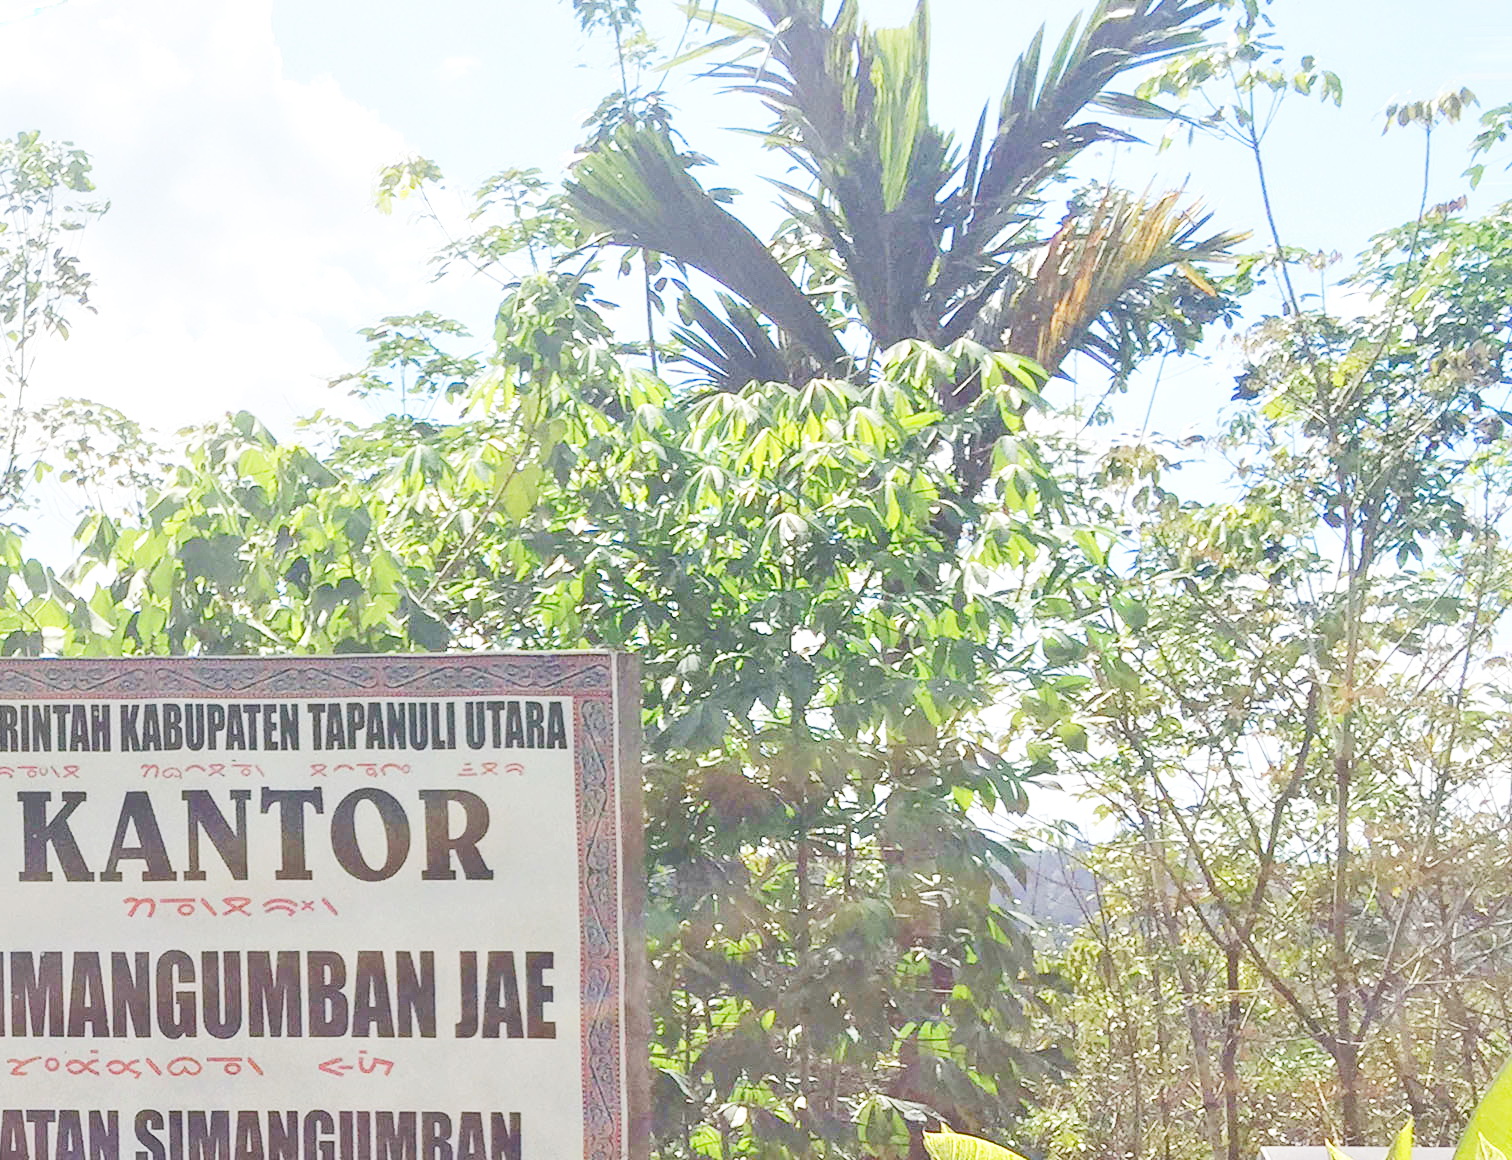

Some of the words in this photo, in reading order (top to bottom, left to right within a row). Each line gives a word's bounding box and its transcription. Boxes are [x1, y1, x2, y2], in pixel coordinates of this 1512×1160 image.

[120, 702, 300, 753] KABUPATEN
[307, 701, 457, 752] TAPANULI
[465, 700, 568, 751] UTARA
[17, 786, 494, 882] KANTOR
[455, 950, 557, 1040] JAE
